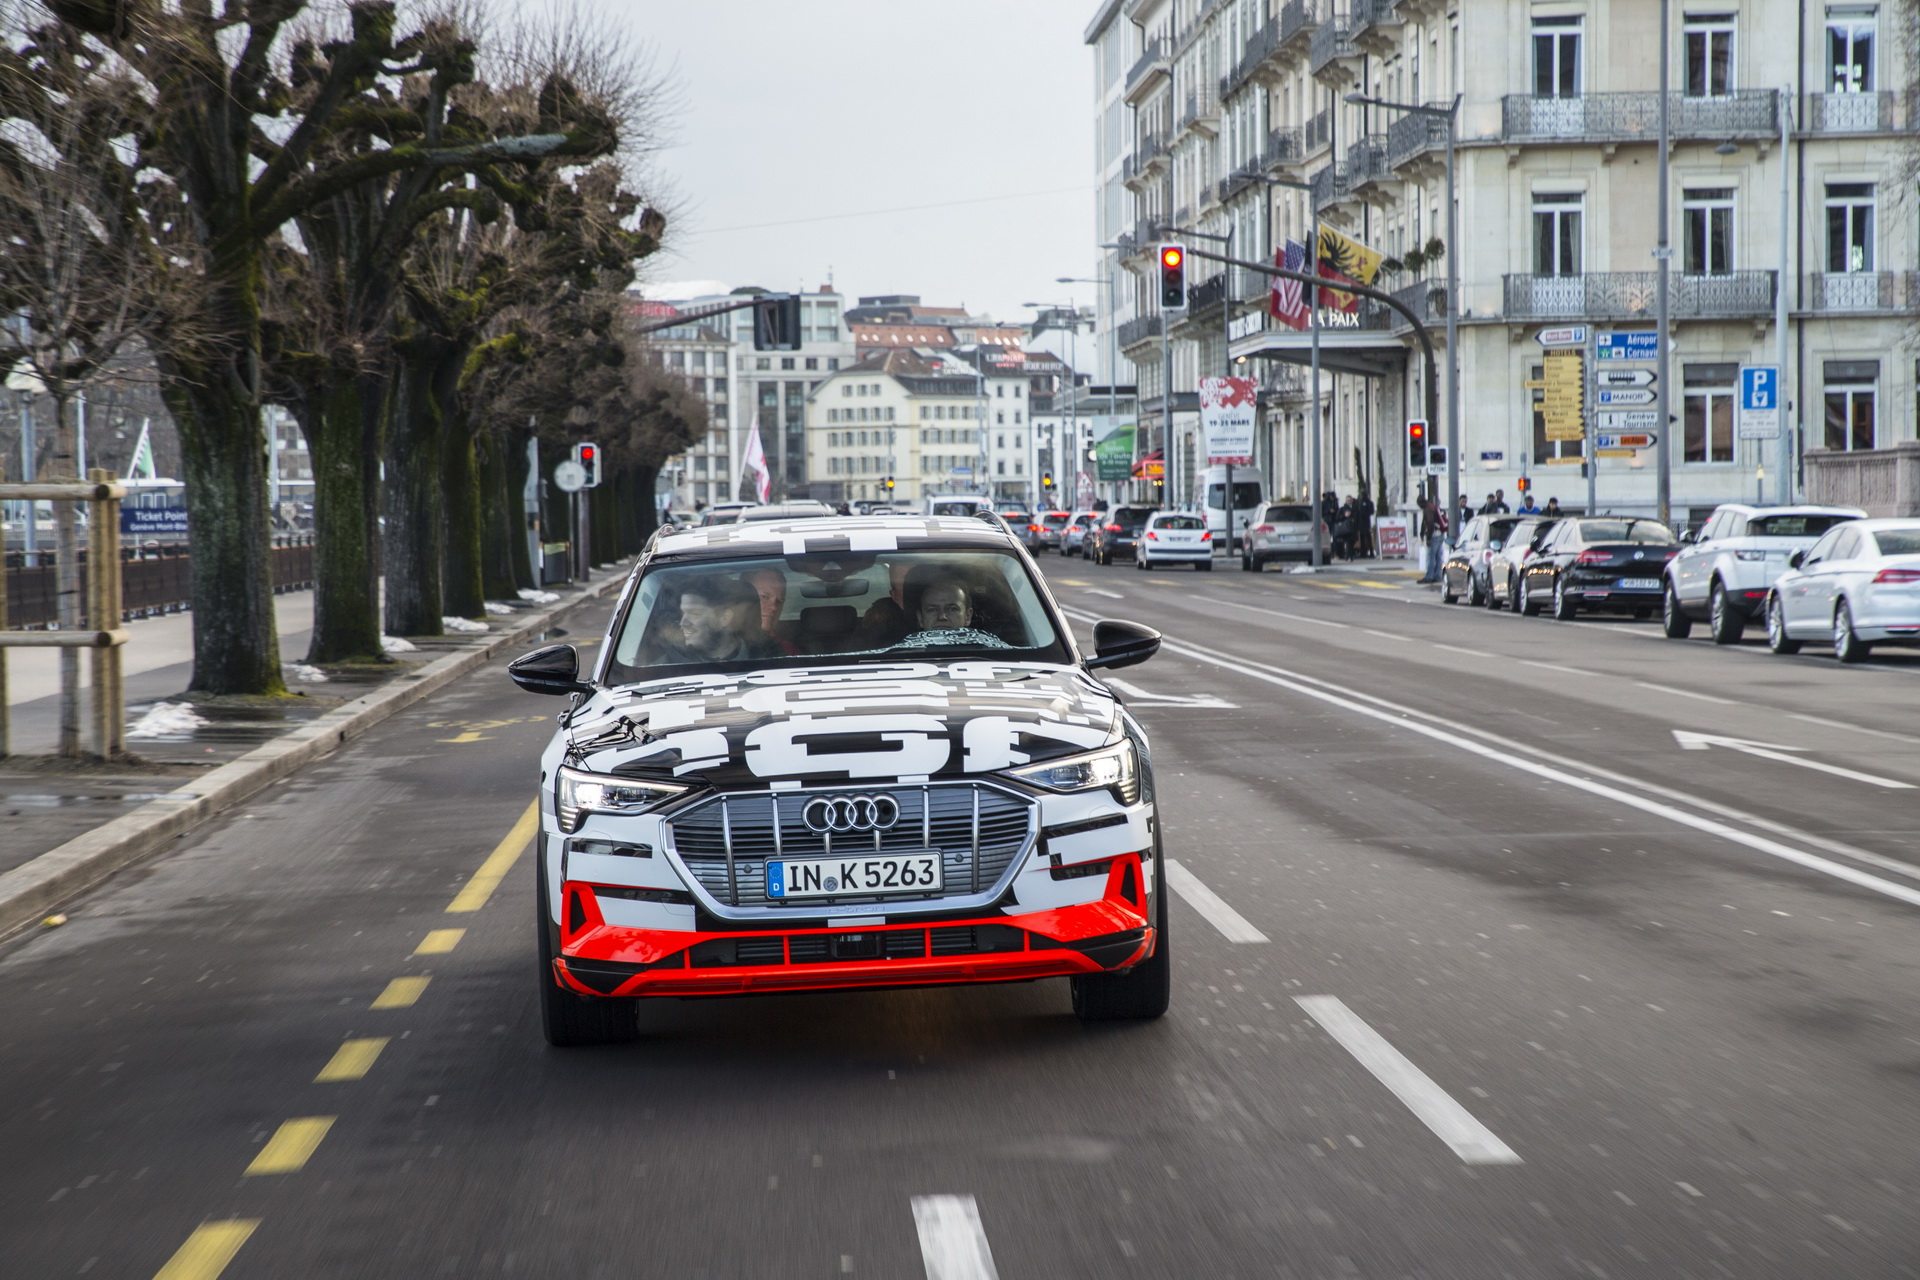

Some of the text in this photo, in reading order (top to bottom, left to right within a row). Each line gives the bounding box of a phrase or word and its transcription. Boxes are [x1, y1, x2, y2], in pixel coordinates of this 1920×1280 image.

[1329, 311, 1360, 328] PAIX
[1627, 333, 1657, 347] Aéropor
[1626, 412, 1655, 420] Genève
[1105, 444, 1125, 452] Salon
[1099, 451, 1132, 460] de l'auto
[135, 511, 188, 521] Ticket Point
[129, 521, 188, 531] Genève Mont-Bla
[788, 859, 935, 892] IN K 5263
[773, 882, 780, 892] D
